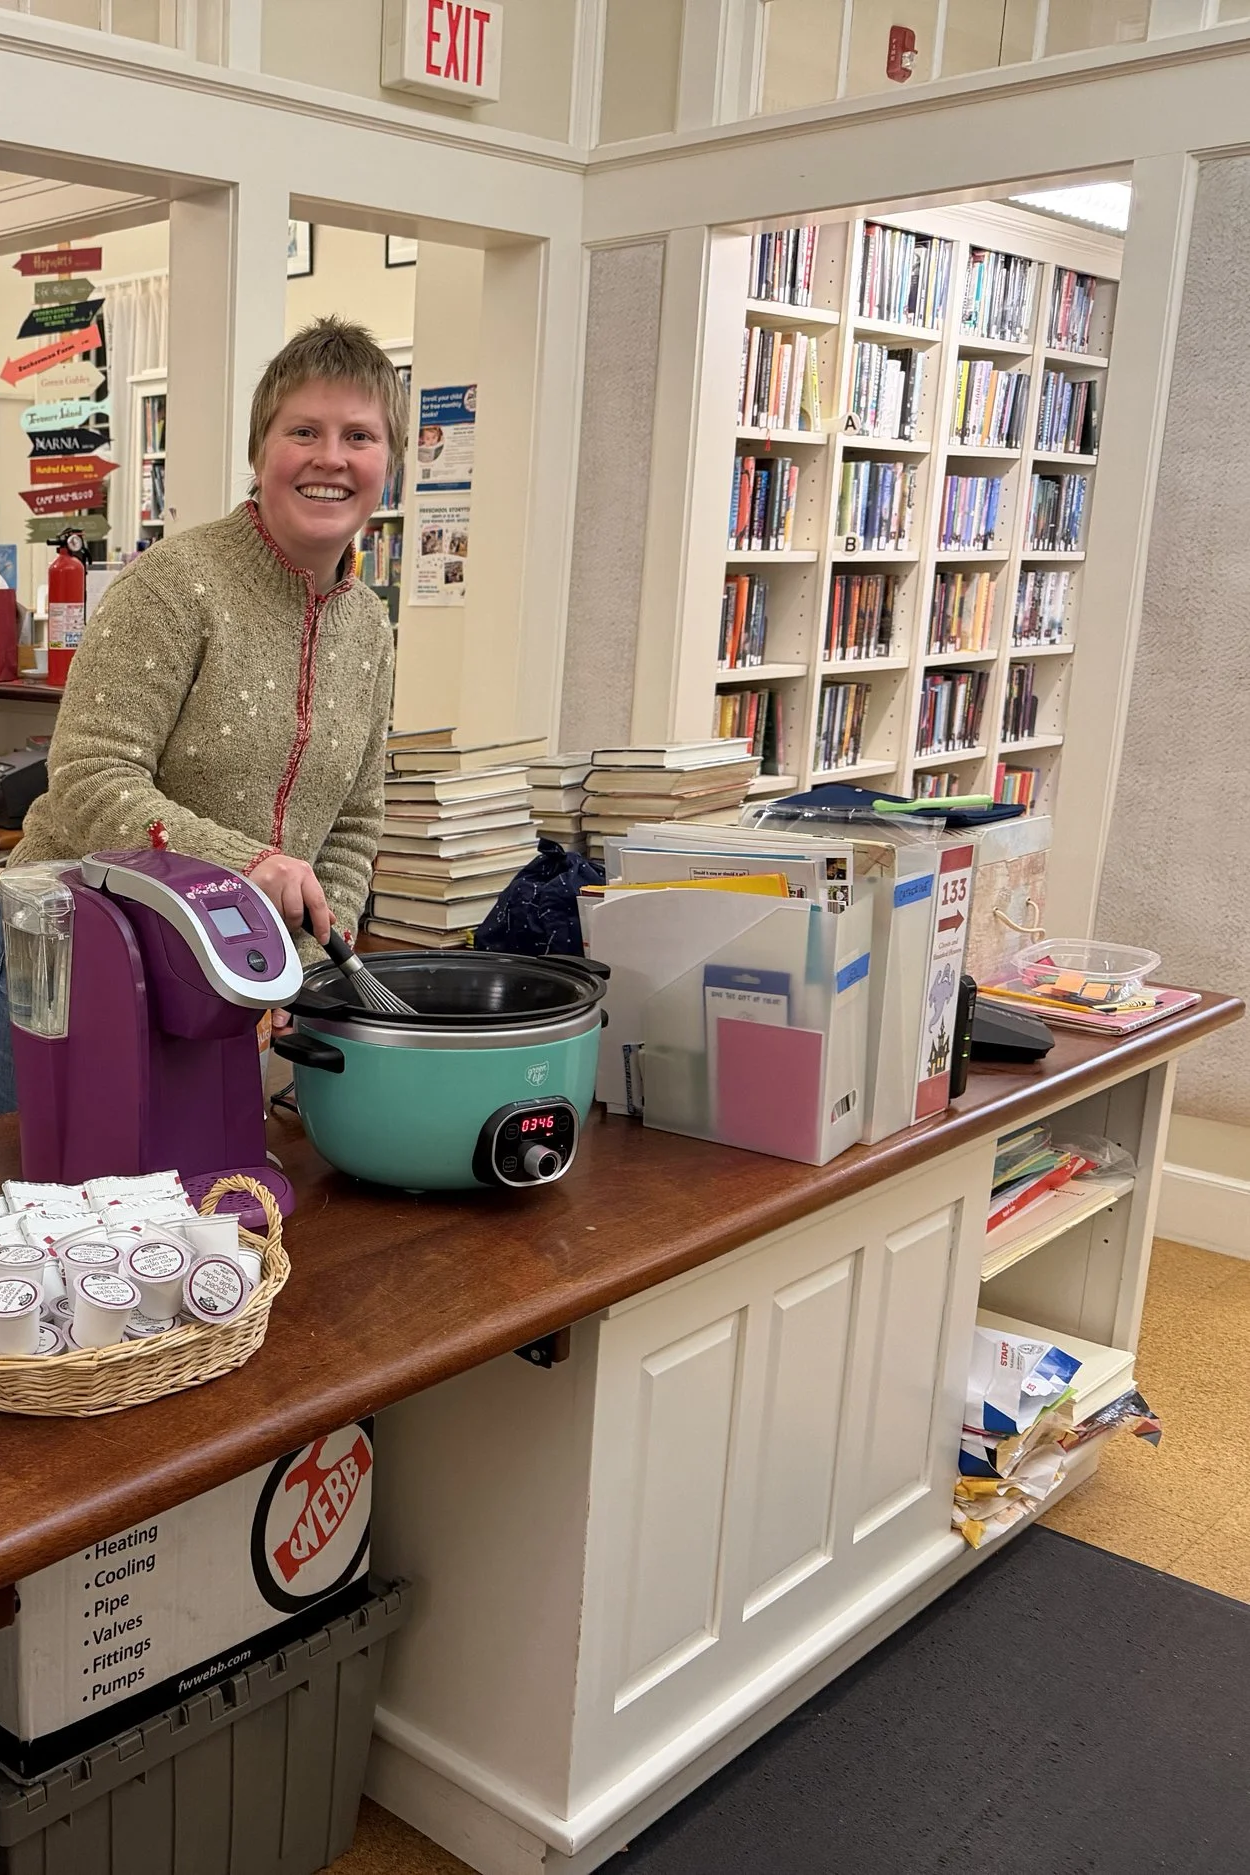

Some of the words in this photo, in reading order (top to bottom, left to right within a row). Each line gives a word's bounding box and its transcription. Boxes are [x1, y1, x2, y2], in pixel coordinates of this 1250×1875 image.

[426, 0, 490, 87] EXIT
[41, 377, 61, 387] Green
[63, 375, 90, 385] Gables
[844, 415, 857, 431] A
[35, 436, 80, 451] NARNIA
[36, 465, 60, 474] Hundred
[844, 537, 856, 551] B
[941, 878, 967, 905] 133
[521, 1115, 554, 1132] 0346
[201, 1270, 219, 1283] cider
[204, 1279, 229, 1296] spiced
[219, 1279, 239, 1294] apple
[290, 1456, 359, 1561] WEBB
[94, 1525, 158, 1560] Heating
[94, 1554, 156, 1588] Cooling
[94, 1593, 130, 1618] Pipe
[92, 1614, 143, 1645] Valves
[92, 1637, 151, 1674] Fittings
[91, 1667, 145, 1701] Pumps
[178, 1650, 251, 1694] fwwebb.com
